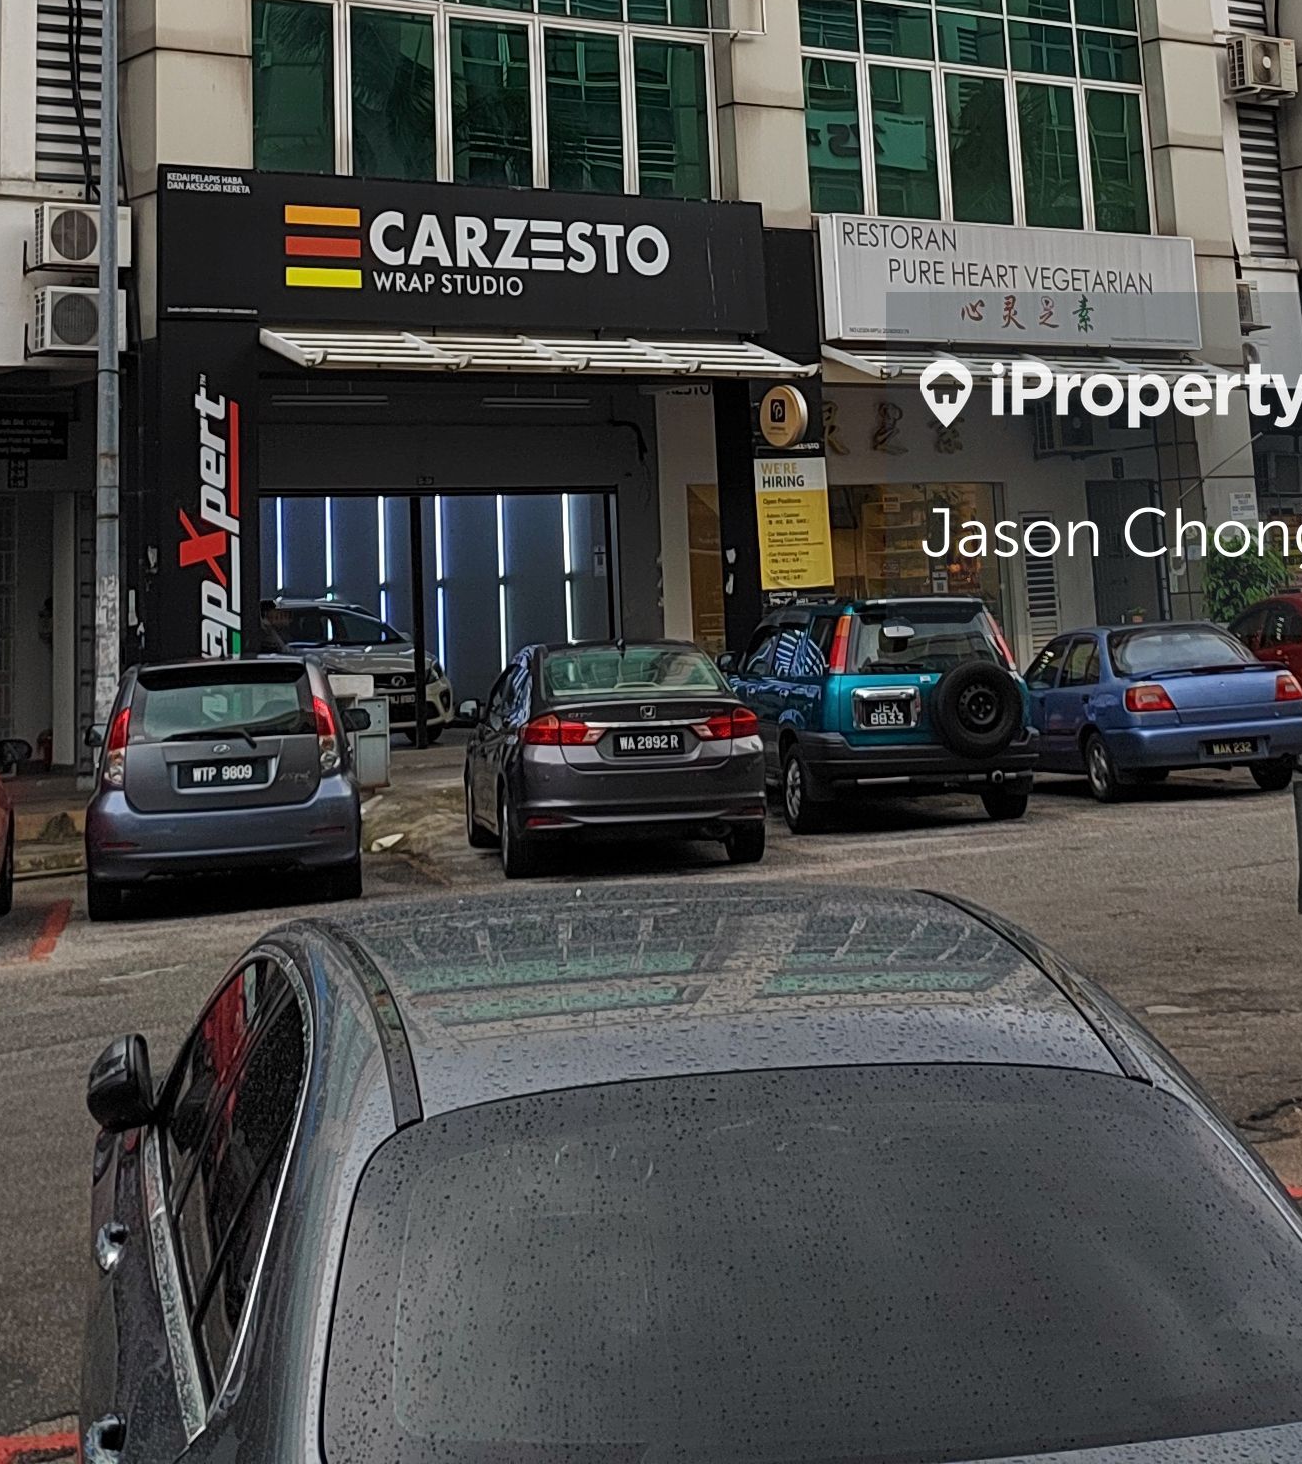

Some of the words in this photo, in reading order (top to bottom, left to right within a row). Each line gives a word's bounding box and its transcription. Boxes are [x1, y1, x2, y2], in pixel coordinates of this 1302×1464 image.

[166, 172, 190, 182] KEDAI
[190, 174, 221, 184] PELAPIS
[221, 176, 243, 185] HABA
[166, 181, 185, 190] DAN
[185, 182, 222, 193] AKSESORI
[222, 184, 251, 194] KERETA
[369, 210, 670, 277] CARZESTO
[843, 222, 957, 252] RESTORAN
[372, 271, 435, 294] WRAP
[441, 273, 524, 297] STUDIO
[889, 258, 945, 285] PURE
[952, 262, 1018, 289] HEART
[1024, 265, 1153, 296] VEGETARIAN
[761, 462, 797, 475] WE'RE
[762, 475, 805, 489] HIRING
[874, 702, 899, 714] JEX
[870, 712, 904, 724] 8833
[619, 736, 635, 750] WA
[637, 735, 668, 749] 2892
[671, 735, 679, 748] R
[192, 767, 217, 782] WTP
[222, 764, 252, 779] 9809
